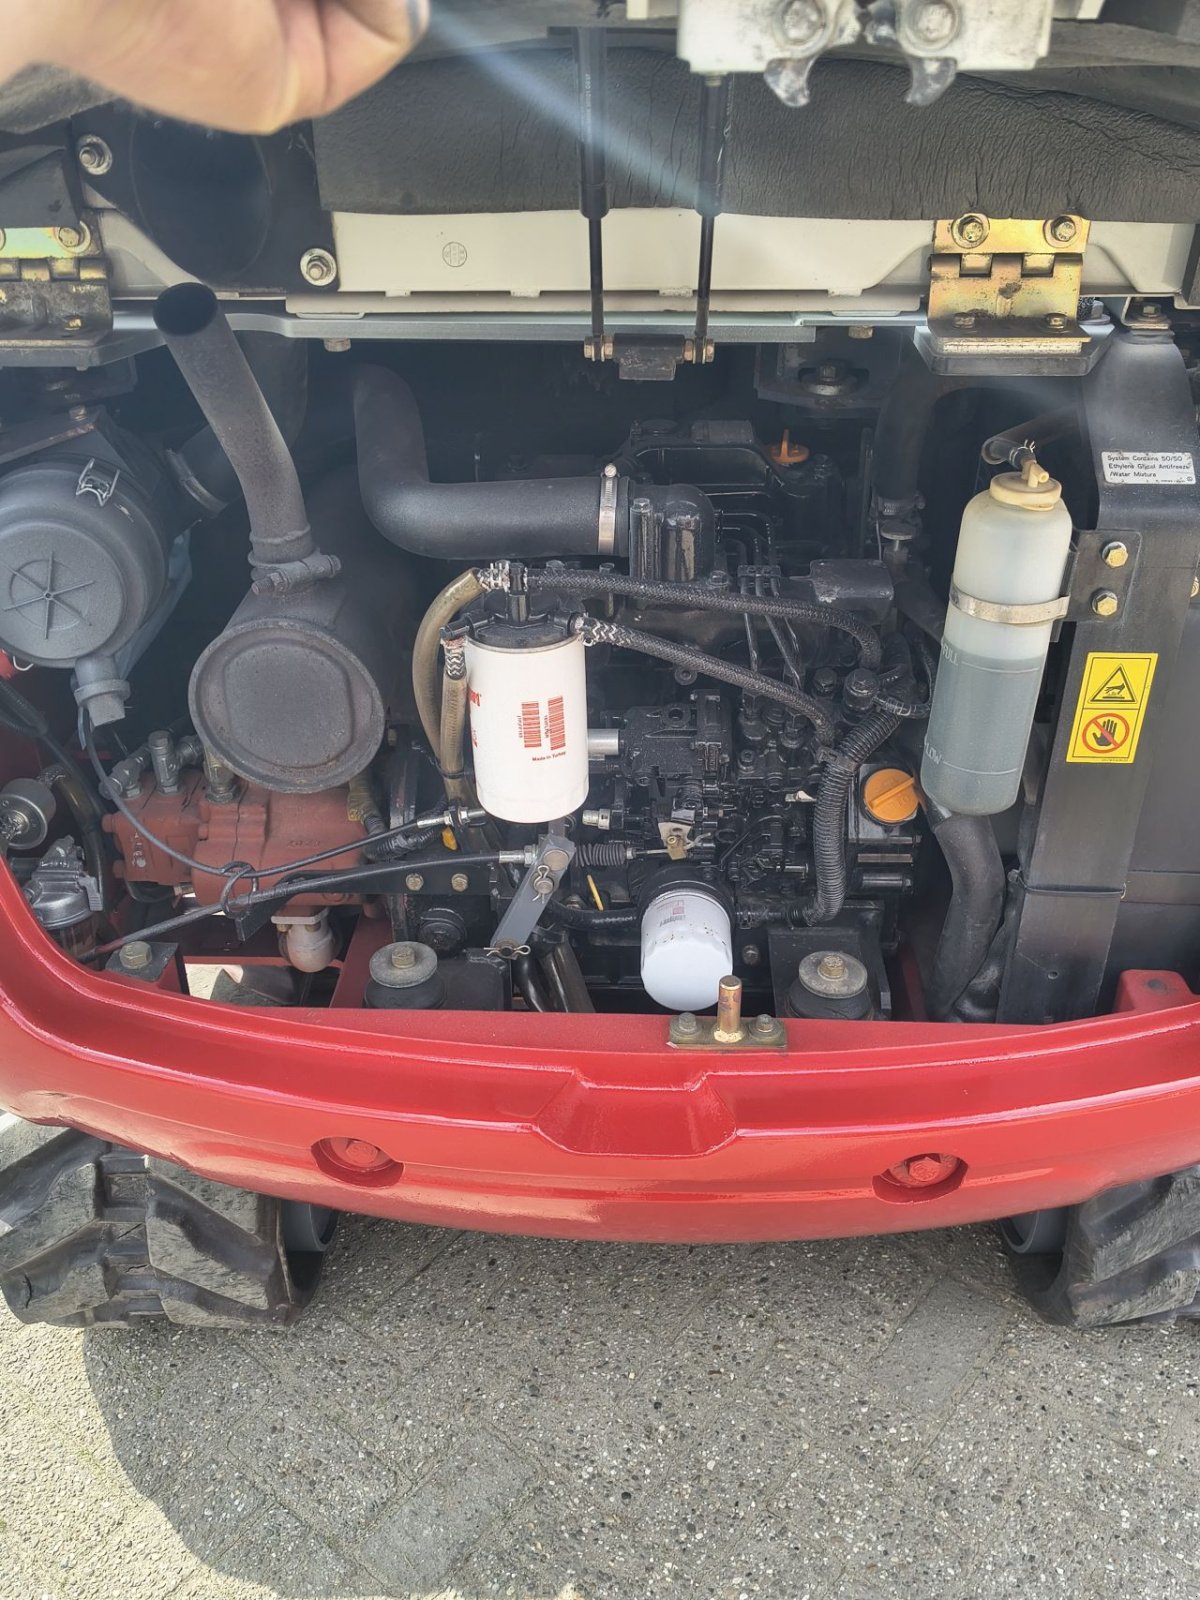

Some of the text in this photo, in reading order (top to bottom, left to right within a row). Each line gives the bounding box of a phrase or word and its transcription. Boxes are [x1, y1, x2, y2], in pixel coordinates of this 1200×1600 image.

[1107, 454, 1130, 462] System
[1108, 462, 1134, 470] Ethylene
[552, 751, 566, 759] Turkey
